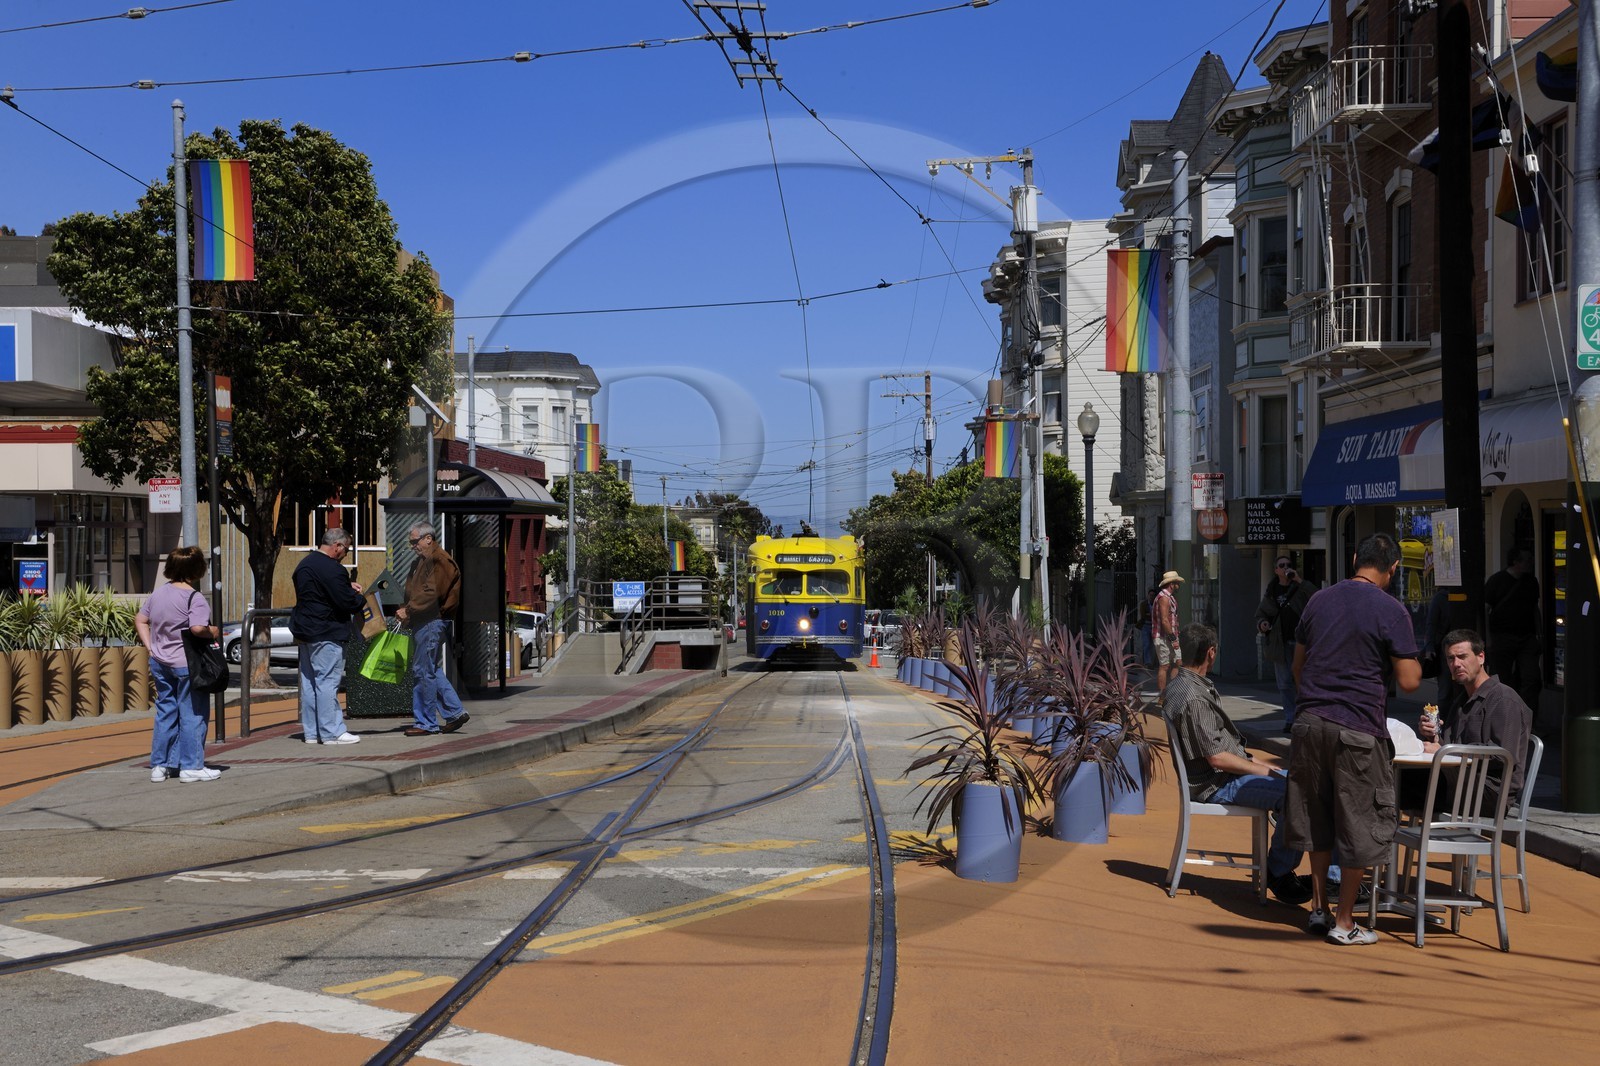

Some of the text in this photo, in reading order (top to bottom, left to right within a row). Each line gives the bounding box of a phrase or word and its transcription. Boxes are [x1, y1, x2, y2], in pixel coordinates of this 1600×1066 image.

[1588, 356, 1600, 366] EA
[1336, 424, 1419, 464] SUN TANN
[1345, 481, 1397, 504] AQUA MASSAGE
